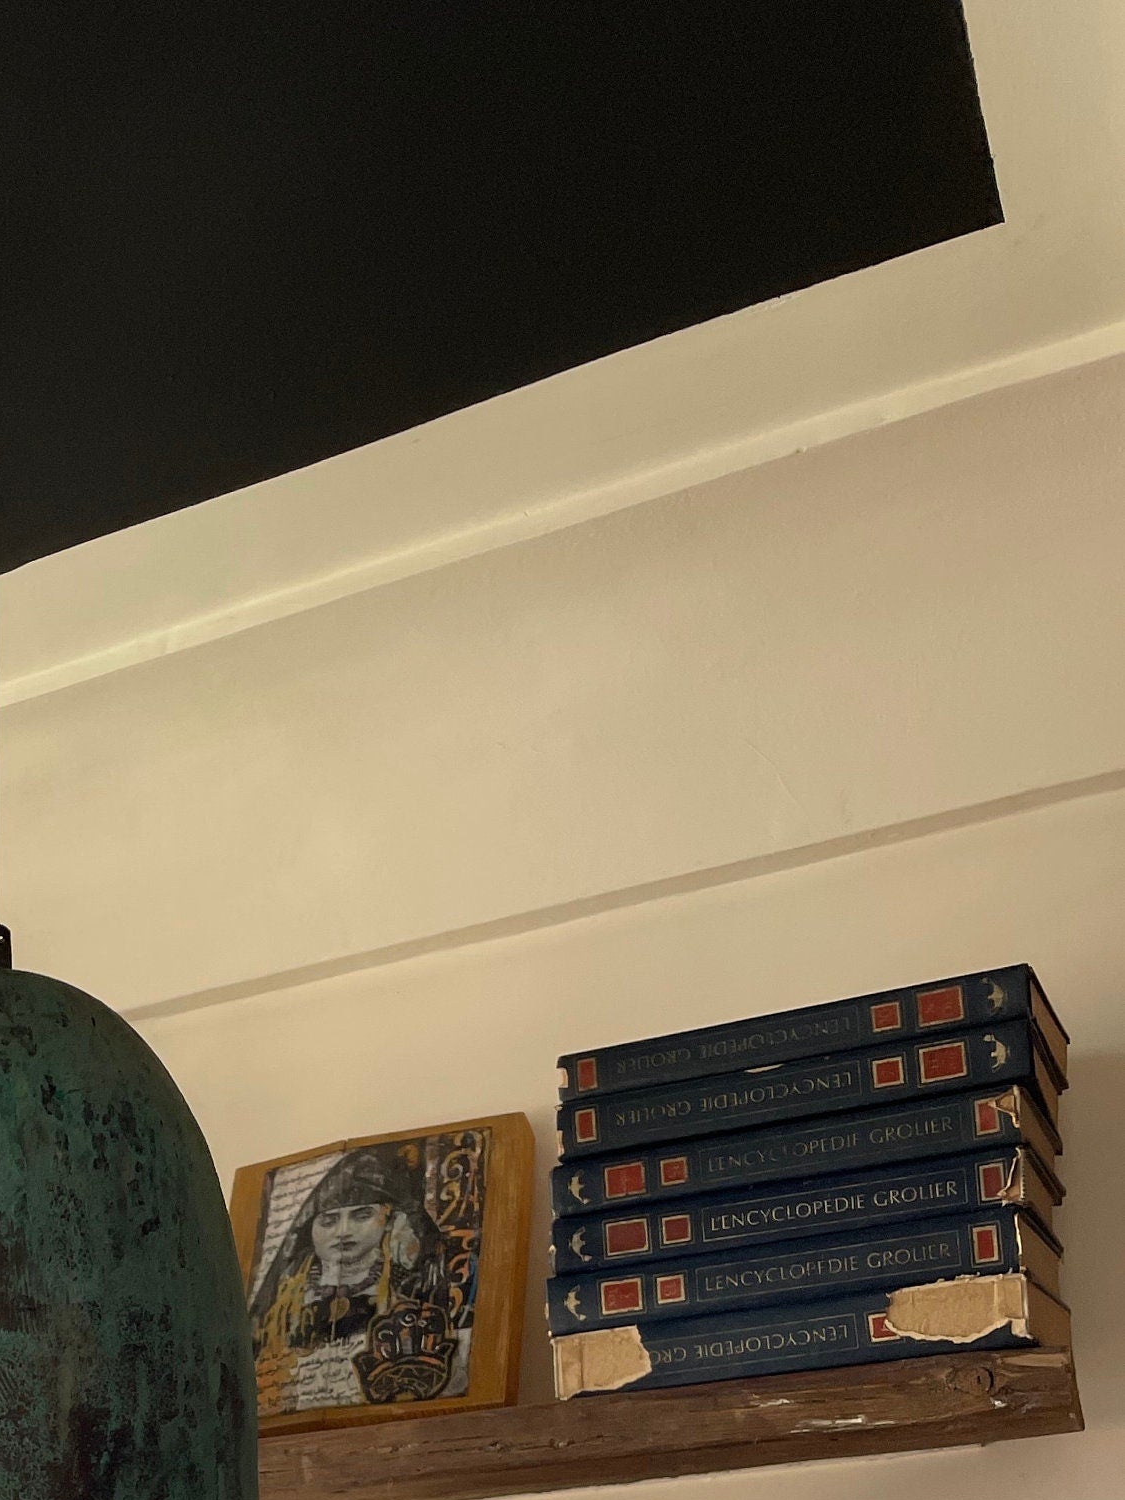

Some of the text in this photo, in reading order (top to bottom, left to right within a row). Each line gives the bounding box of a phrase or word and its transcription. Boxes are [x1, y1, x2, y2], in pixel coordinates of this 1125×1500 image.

[615, 1099, 692, 1128] GROLIER
[868, 1115, 954, 1145] GROLIER
[872, 1180, 958, 1208] GROLIER
[866, 1242, 951, 1269] GROLIER
